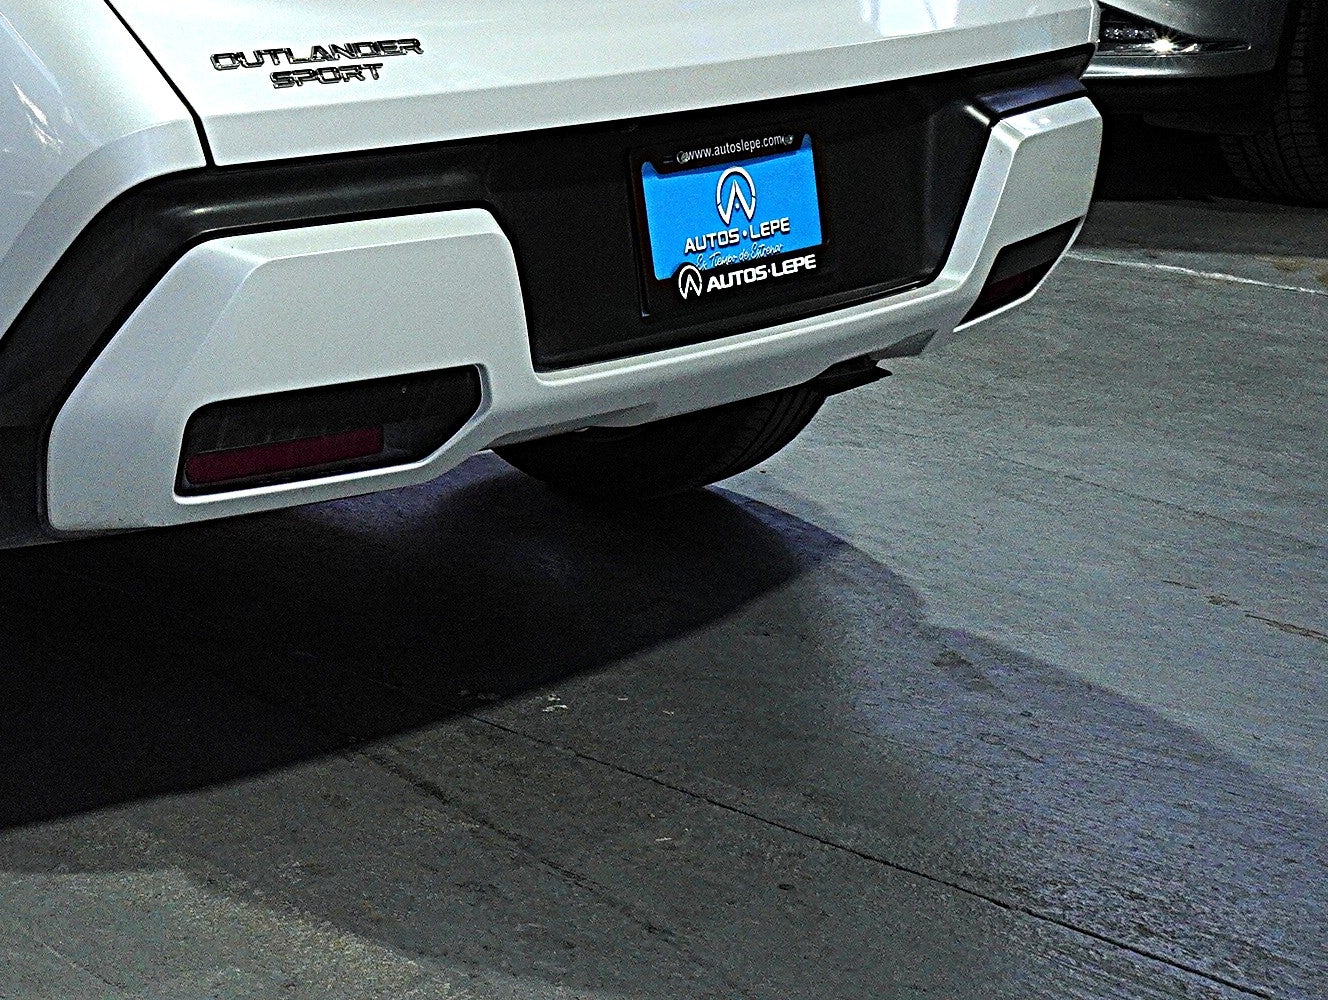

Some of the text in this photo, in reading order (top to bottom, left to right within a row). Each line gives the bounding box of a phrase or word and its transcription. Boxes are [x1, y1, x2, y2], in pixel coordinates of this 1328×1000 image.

[209, 38, 424, 71] OUTLANDER
[269, 63, 383, 89] SPORT
[686, 134, 785, 160] www.autoslepe.com
